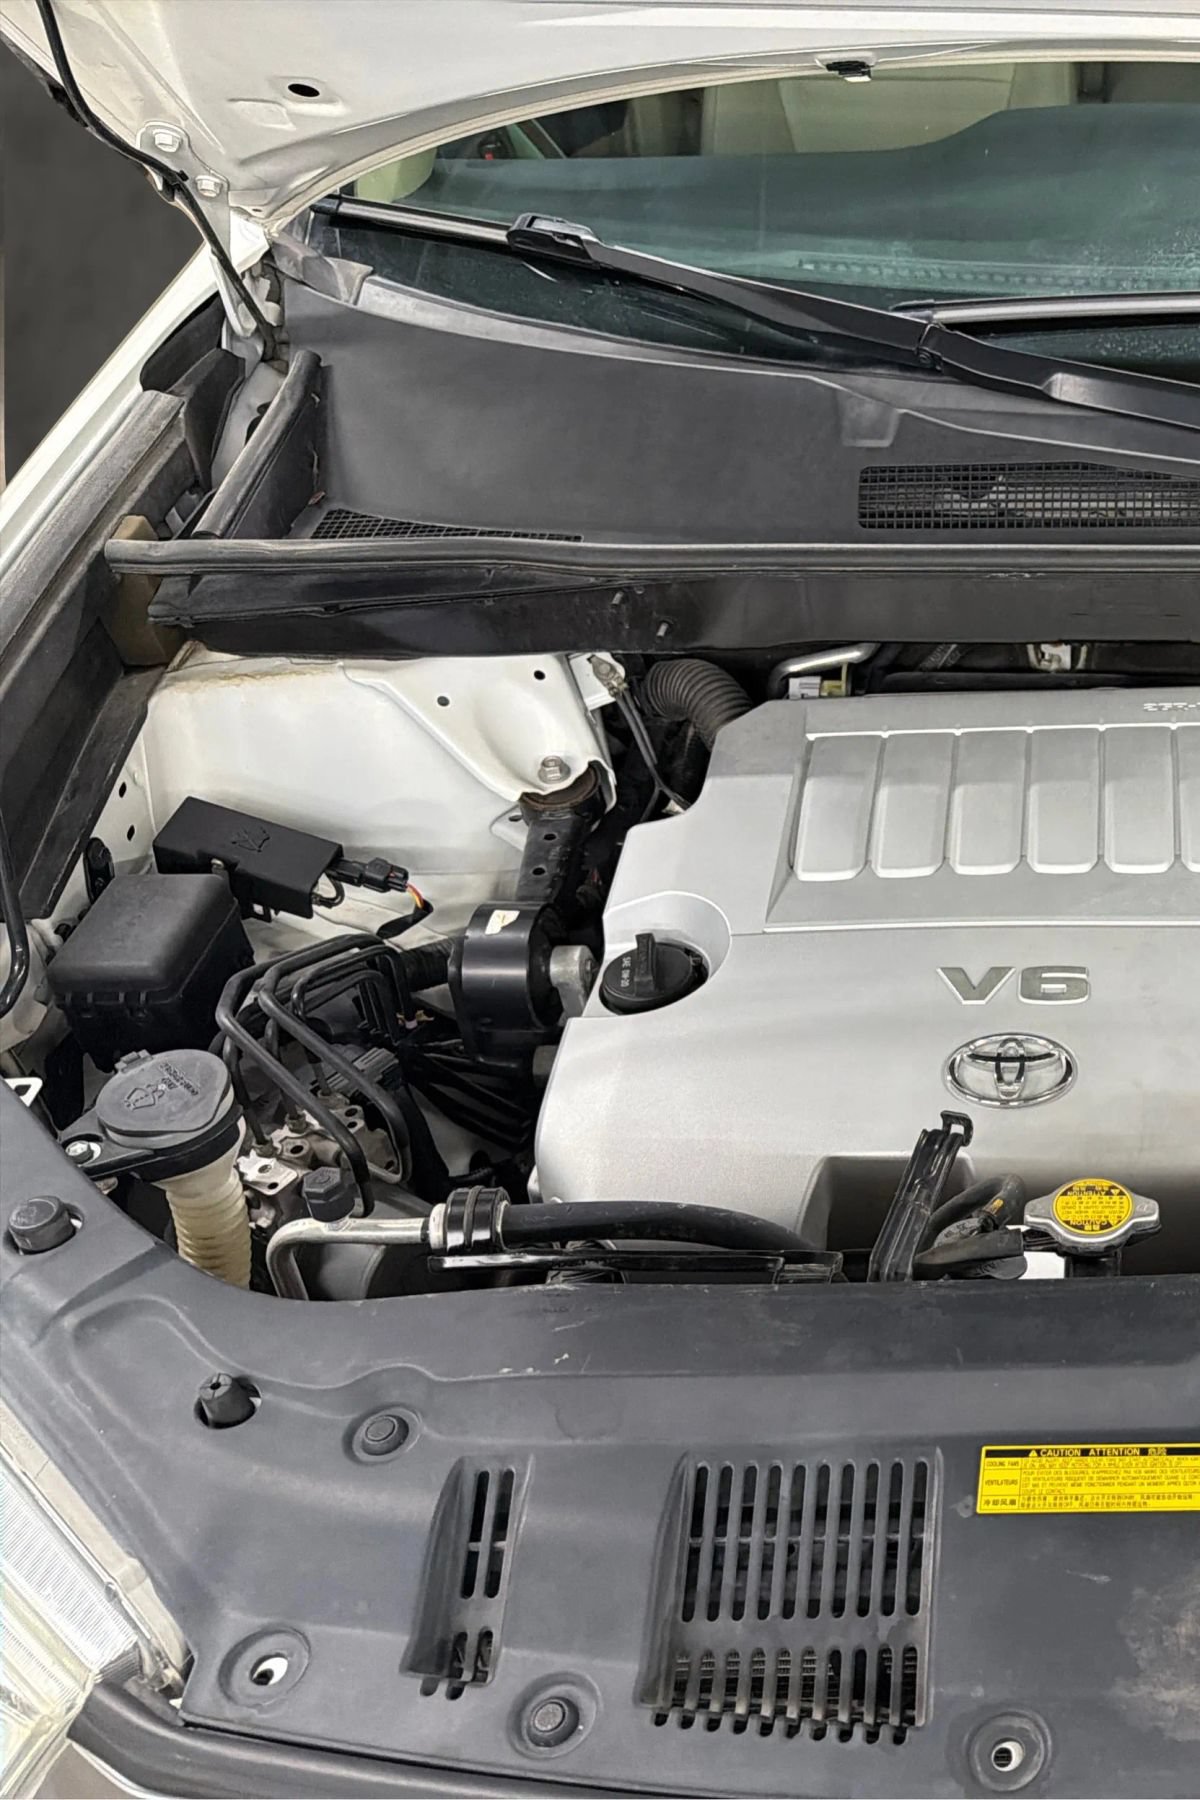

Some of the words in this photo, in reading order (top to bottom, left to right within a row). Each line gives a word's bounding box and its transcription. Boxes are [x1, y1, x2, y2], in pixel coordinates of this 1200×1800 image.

[936, 965, 1091, 1005] V6
[1040, 1448, 1081, 1457] CAUTION
[1089, 1447, 1140, 1456] ATTENTION
[985, 1479, 1018, 1487] VENTILATEURS
